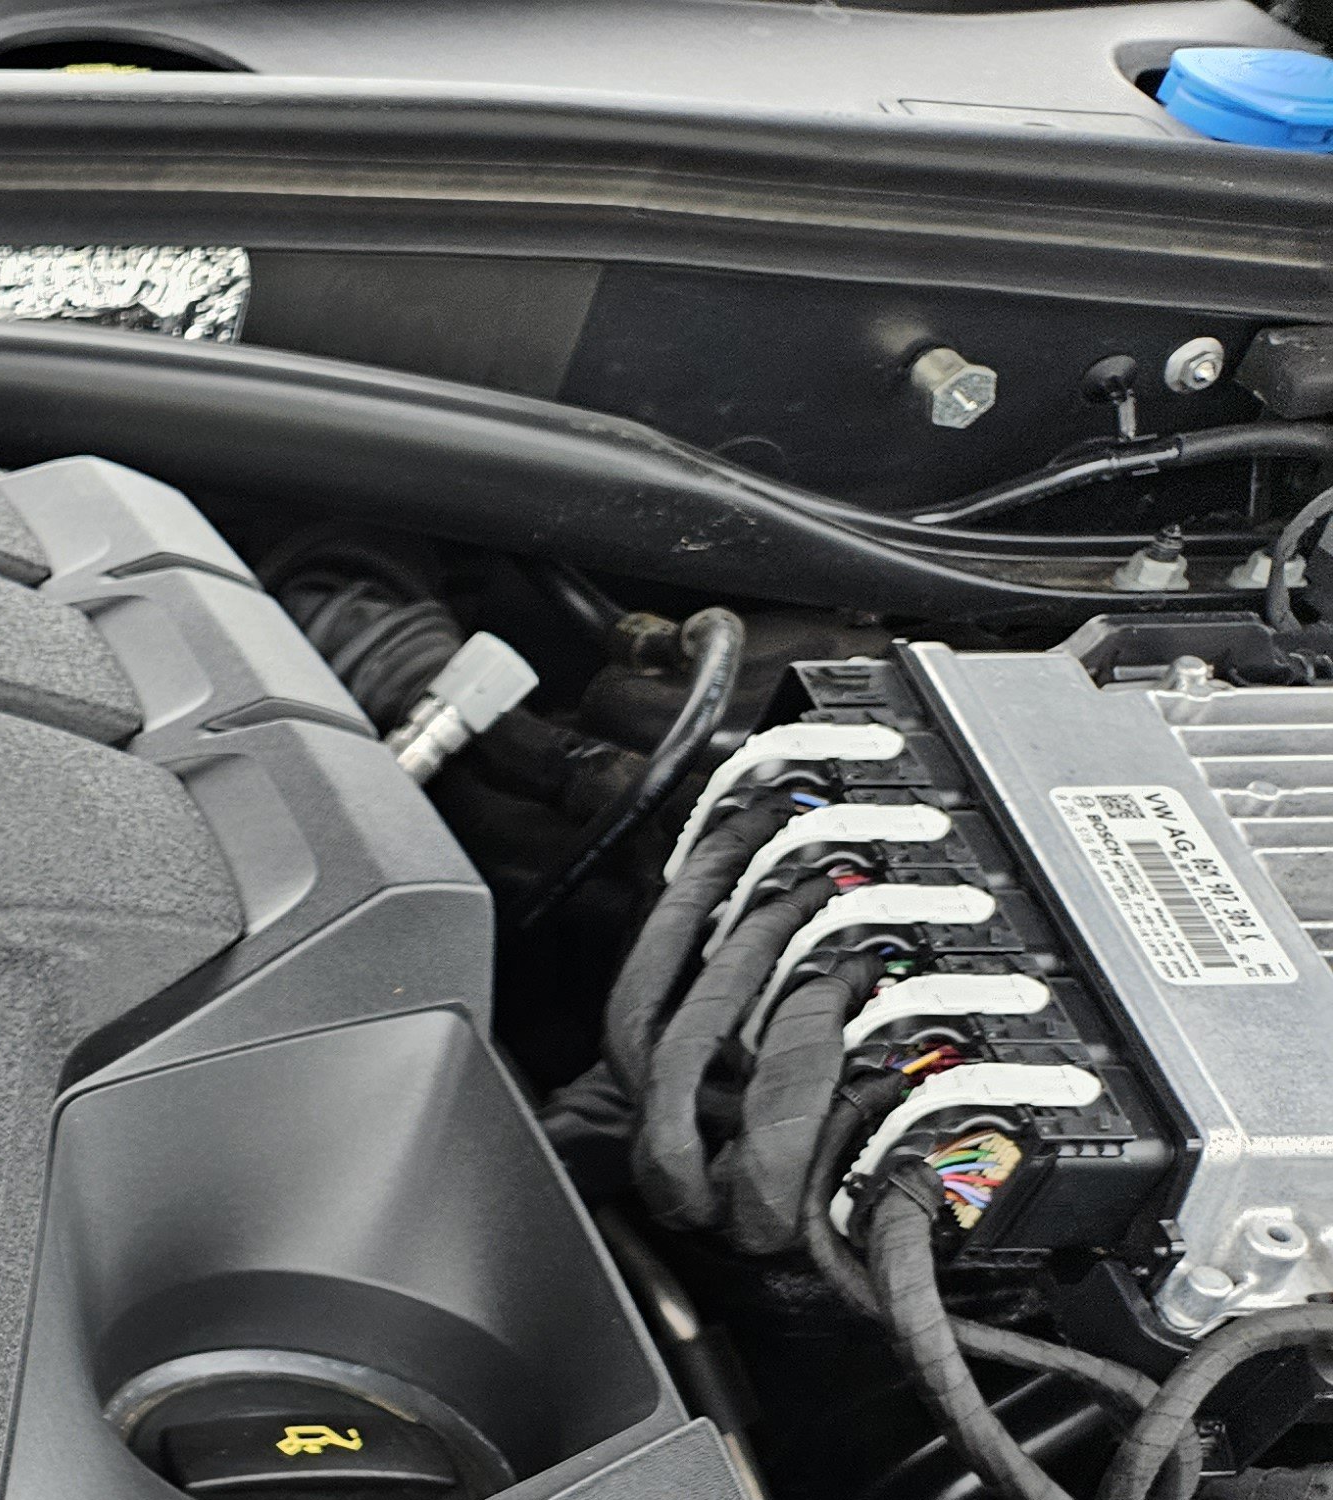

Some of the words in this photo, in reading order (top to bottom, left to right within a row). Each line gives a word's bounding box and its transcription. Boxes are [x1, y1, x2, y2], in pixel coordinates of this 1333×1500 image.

[1086, 814, 1125, 856] BOSCH
[1143, 793, 1178, 821] VW
[1163, 826, 1196, 852] AG
[1206, 883, 1239, 902] 907
